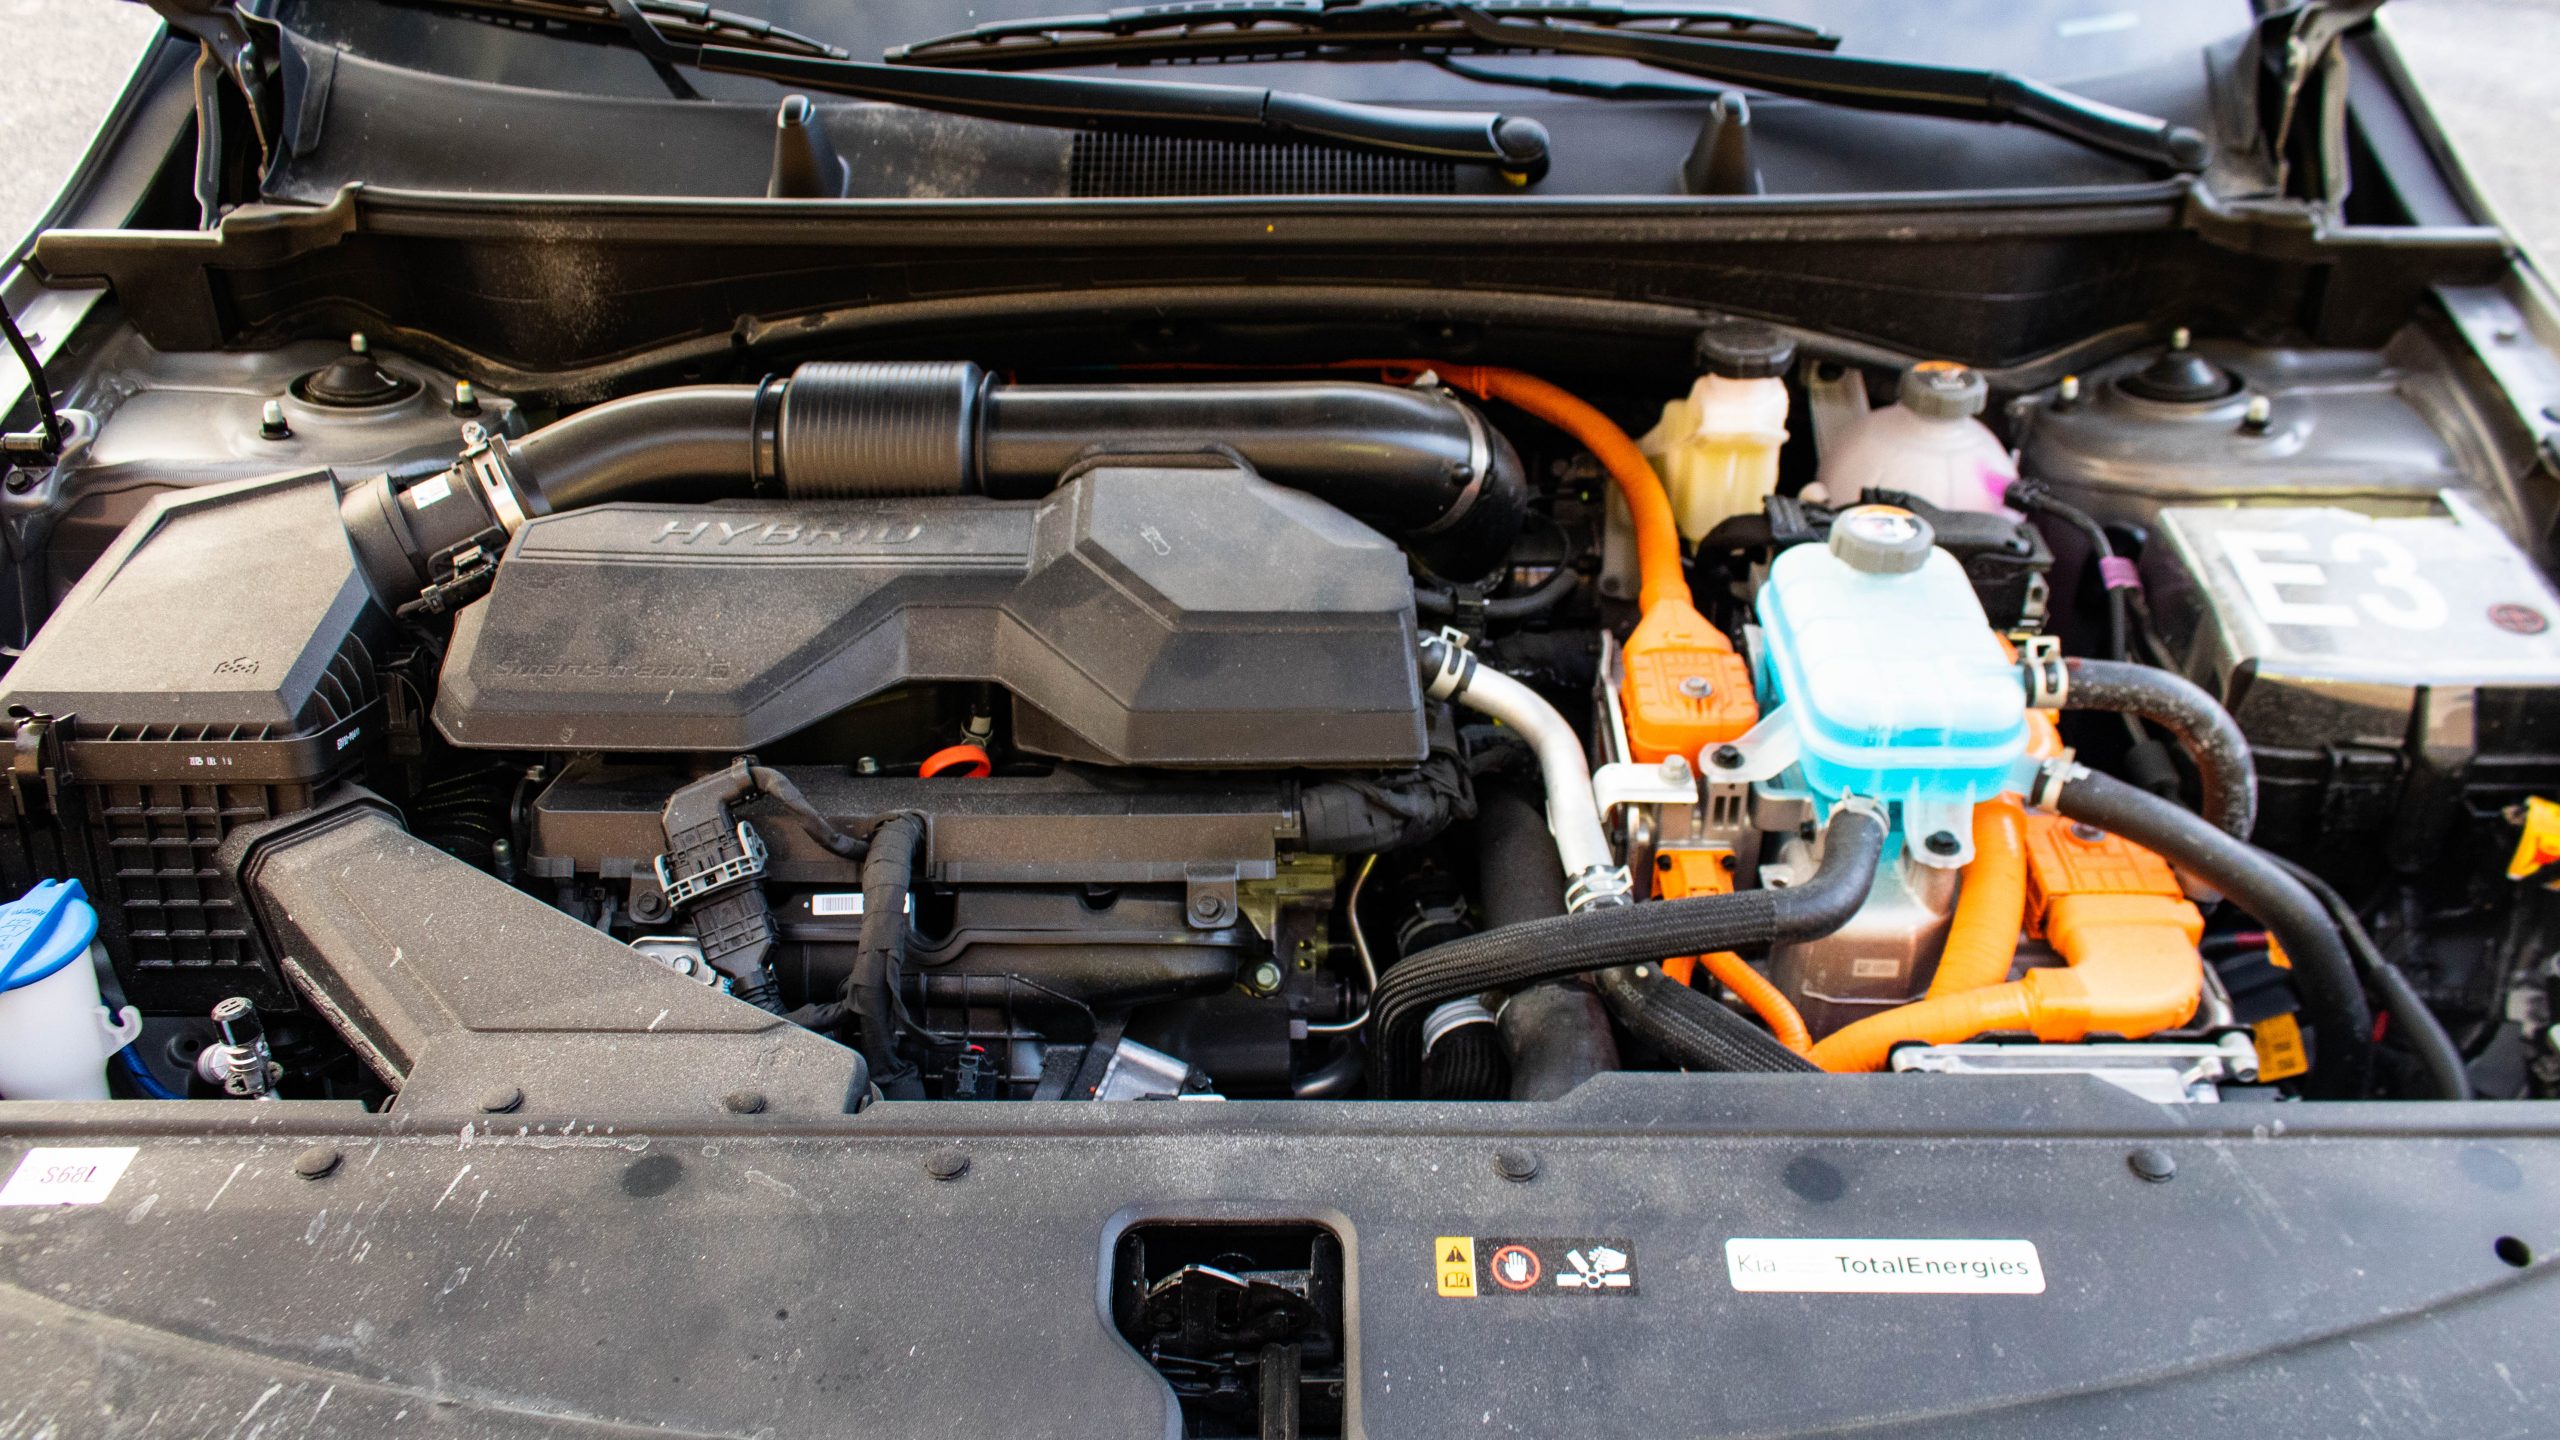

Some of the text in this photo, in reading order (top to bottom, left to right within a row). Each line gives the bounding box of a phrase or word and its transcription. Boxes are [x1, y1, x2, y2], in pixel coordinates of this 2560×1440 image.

[651, 520, 925, 546] HYBRID
[2215, 530, 2448, 631] E3
[1737, 1254, 1777, 1274] Kia
[1835, 1255, 2030, 1278] TotalEnergies
